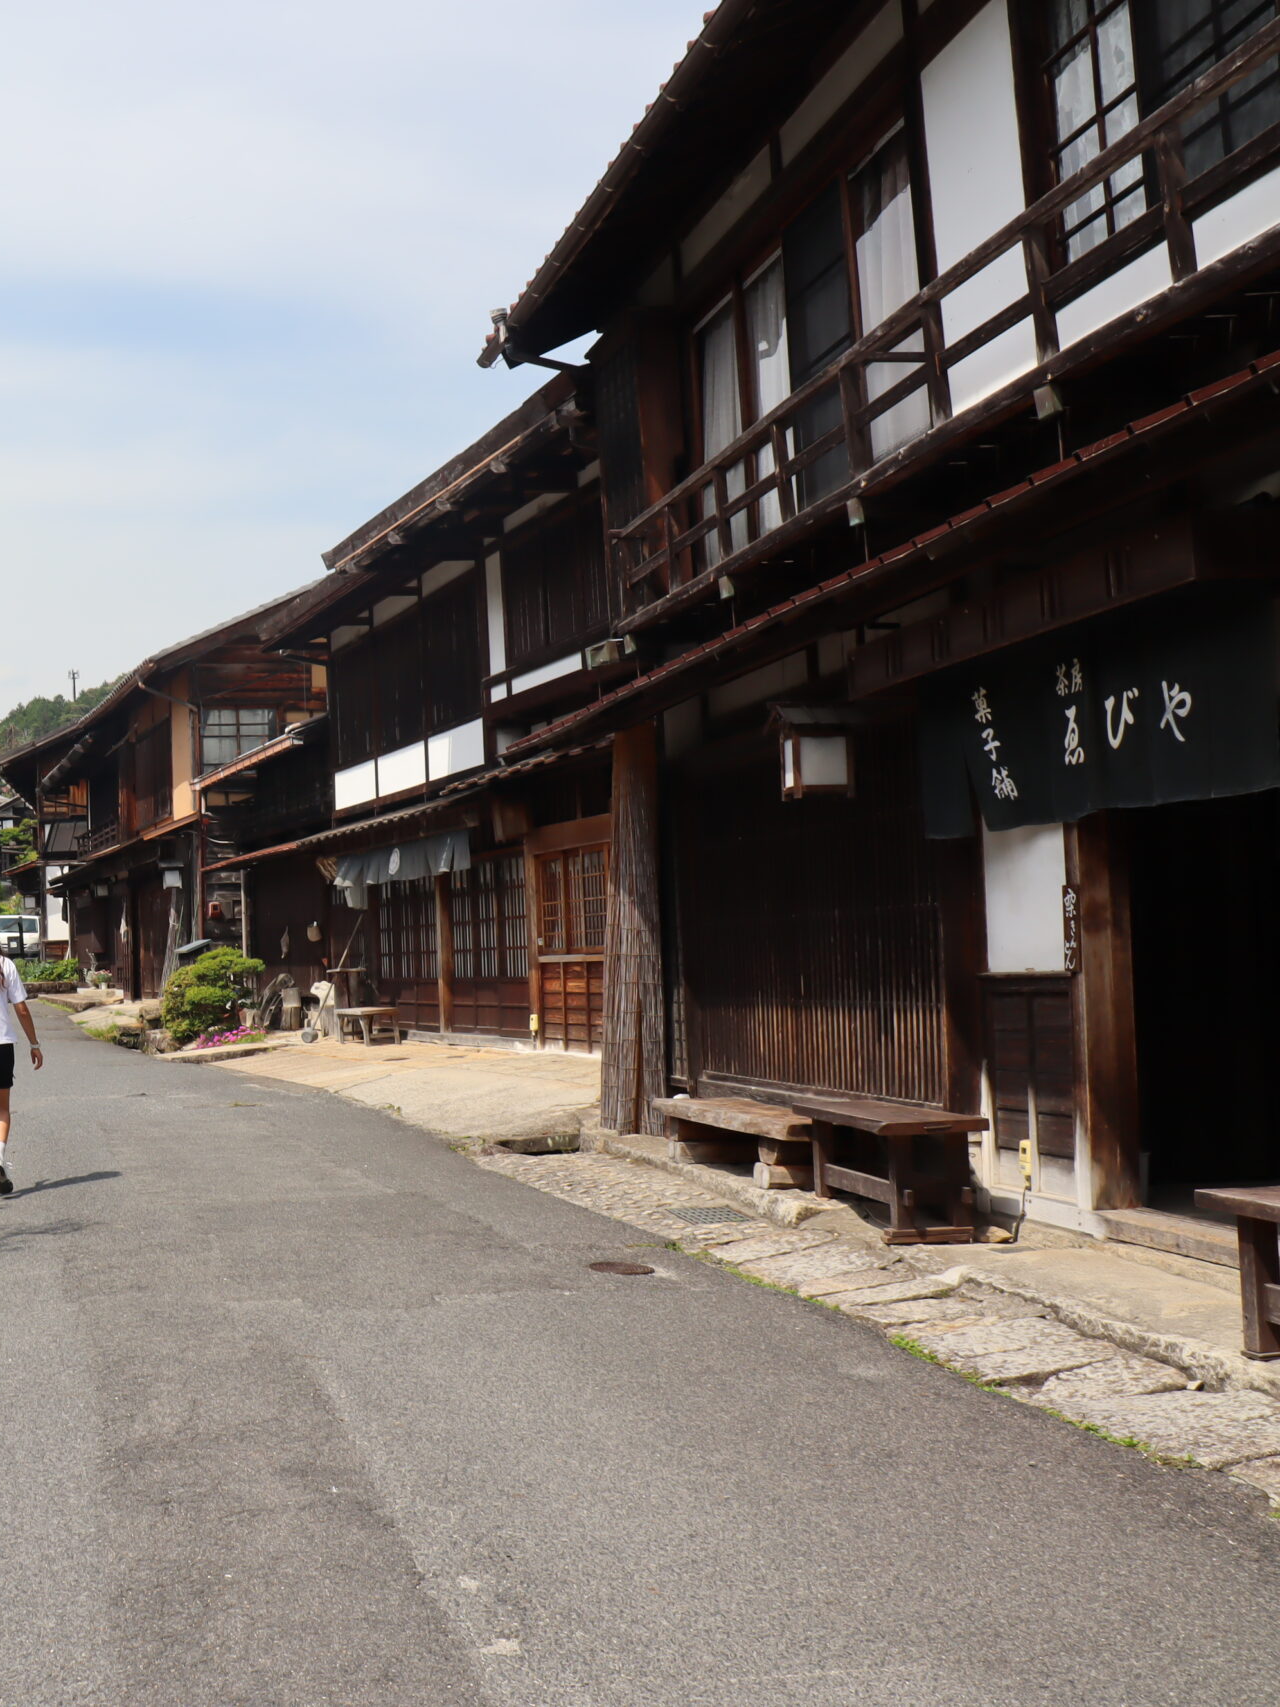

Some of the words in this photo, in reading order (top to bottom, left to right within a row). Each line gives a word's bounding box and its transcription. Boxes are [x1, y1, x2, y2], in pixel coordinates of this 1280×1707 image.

[1056, 657, 1083, 698] 茶房
[971, 686, 1019, 801] 菓子舗
